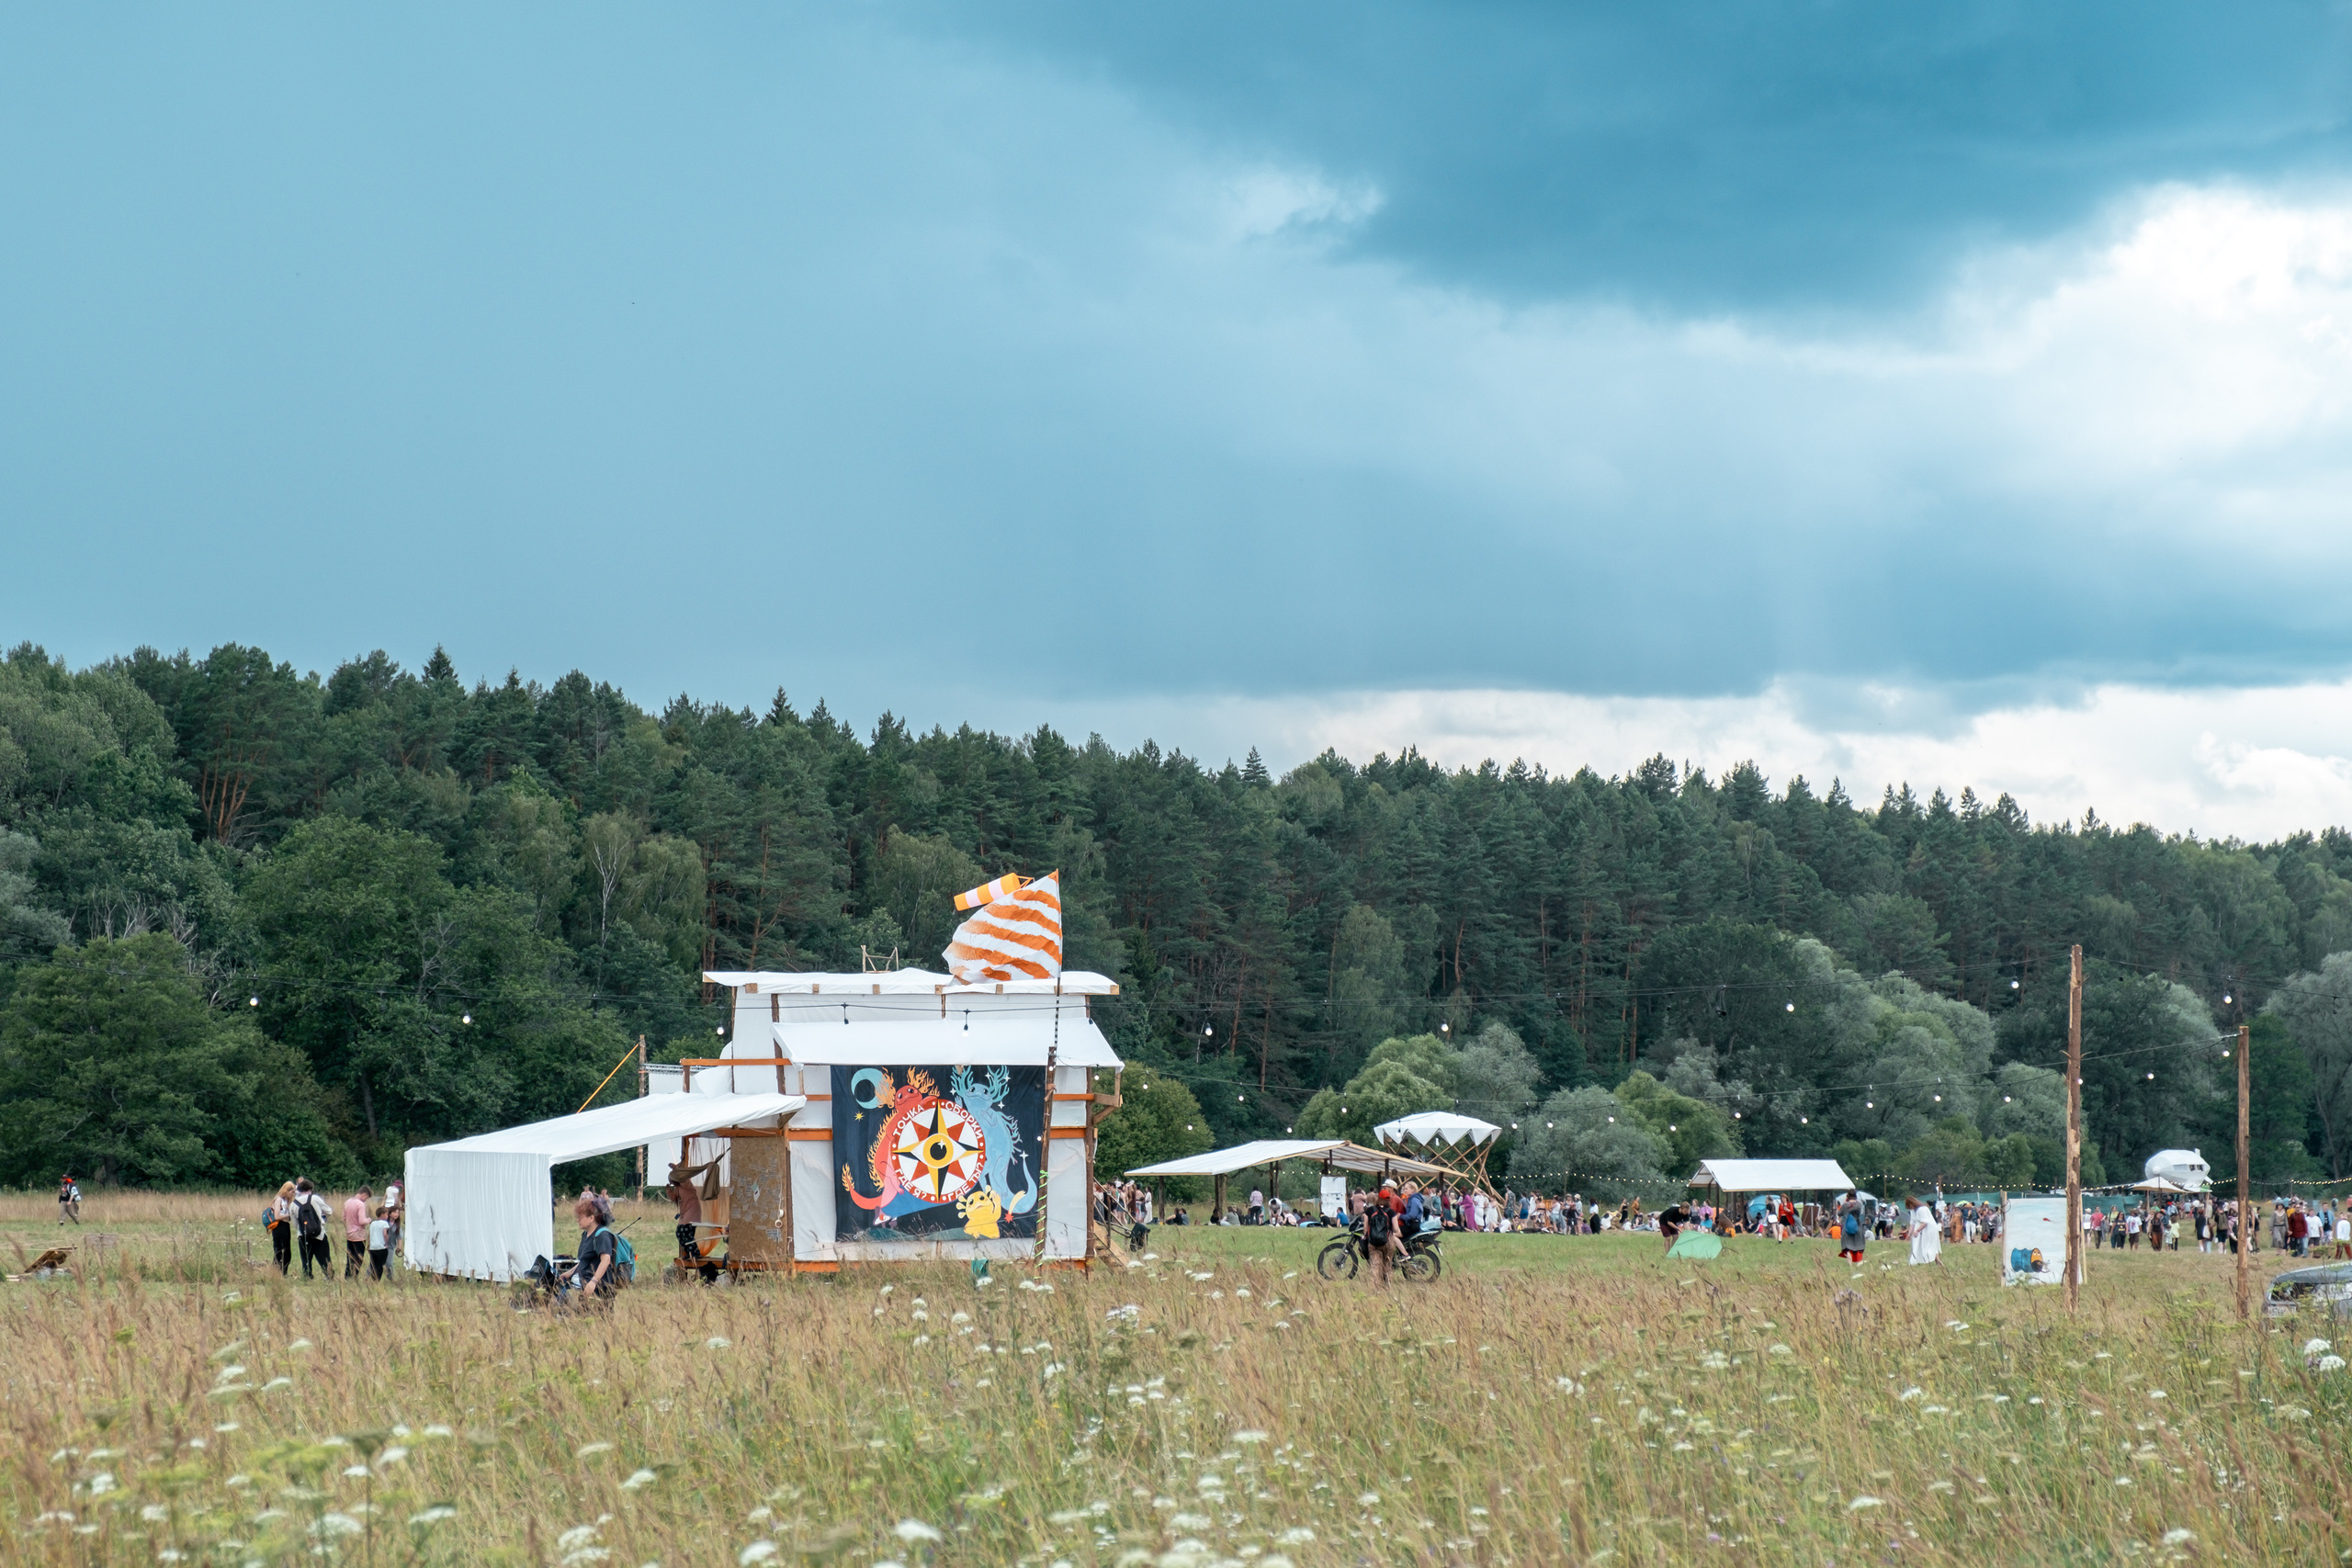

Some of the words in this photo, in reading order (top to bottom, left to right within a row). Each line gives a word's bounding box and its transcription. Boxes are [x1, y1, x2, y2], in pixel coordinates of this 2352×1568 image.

[893, 1104, 924, 1136] ТОЧКА
[945, 1101, 983, 1139] СБОРКИ
[895, 1168, 913, 1192] ГДЕ
[913, 1188, 927, 1200] Я?
[947, 1183, 971, 1201] ГДЕ
[968, 1162, 984, 1183] ТЫ?
